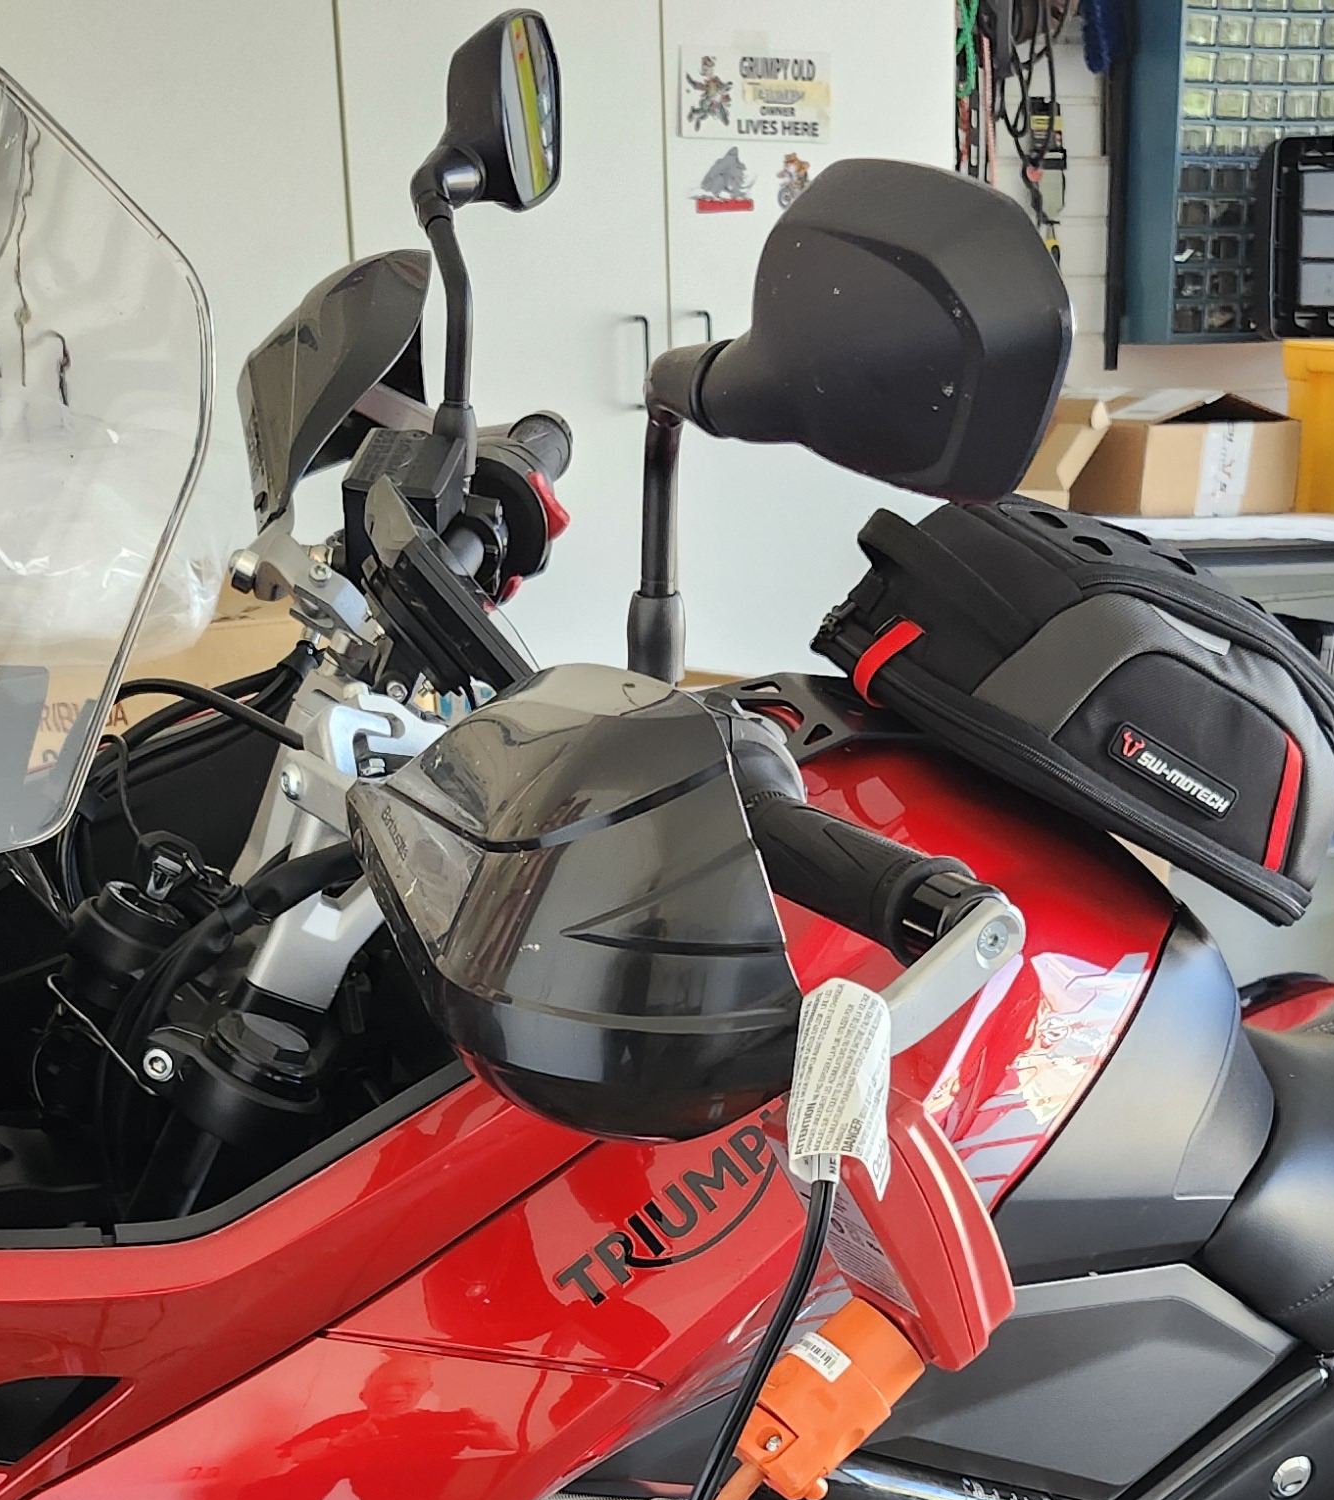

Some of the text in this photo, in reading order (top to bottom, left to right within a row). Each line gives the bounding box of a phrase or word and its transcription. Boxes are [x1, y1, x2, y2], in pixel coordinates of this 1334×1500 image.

[739, 56, 816, 81] GRUMPY OLD
[736, 119, 819, 137] LIVES HERE
[759, 106, 796, 117] OWNER
[1137, 749, 1231, 814] SW-MOTECH
[794, 1102, 816, 1155] ATTENTION
[840, 1117, 864, 1152] DANGER
[556, 1095, 788, 1306] TRIUMP
